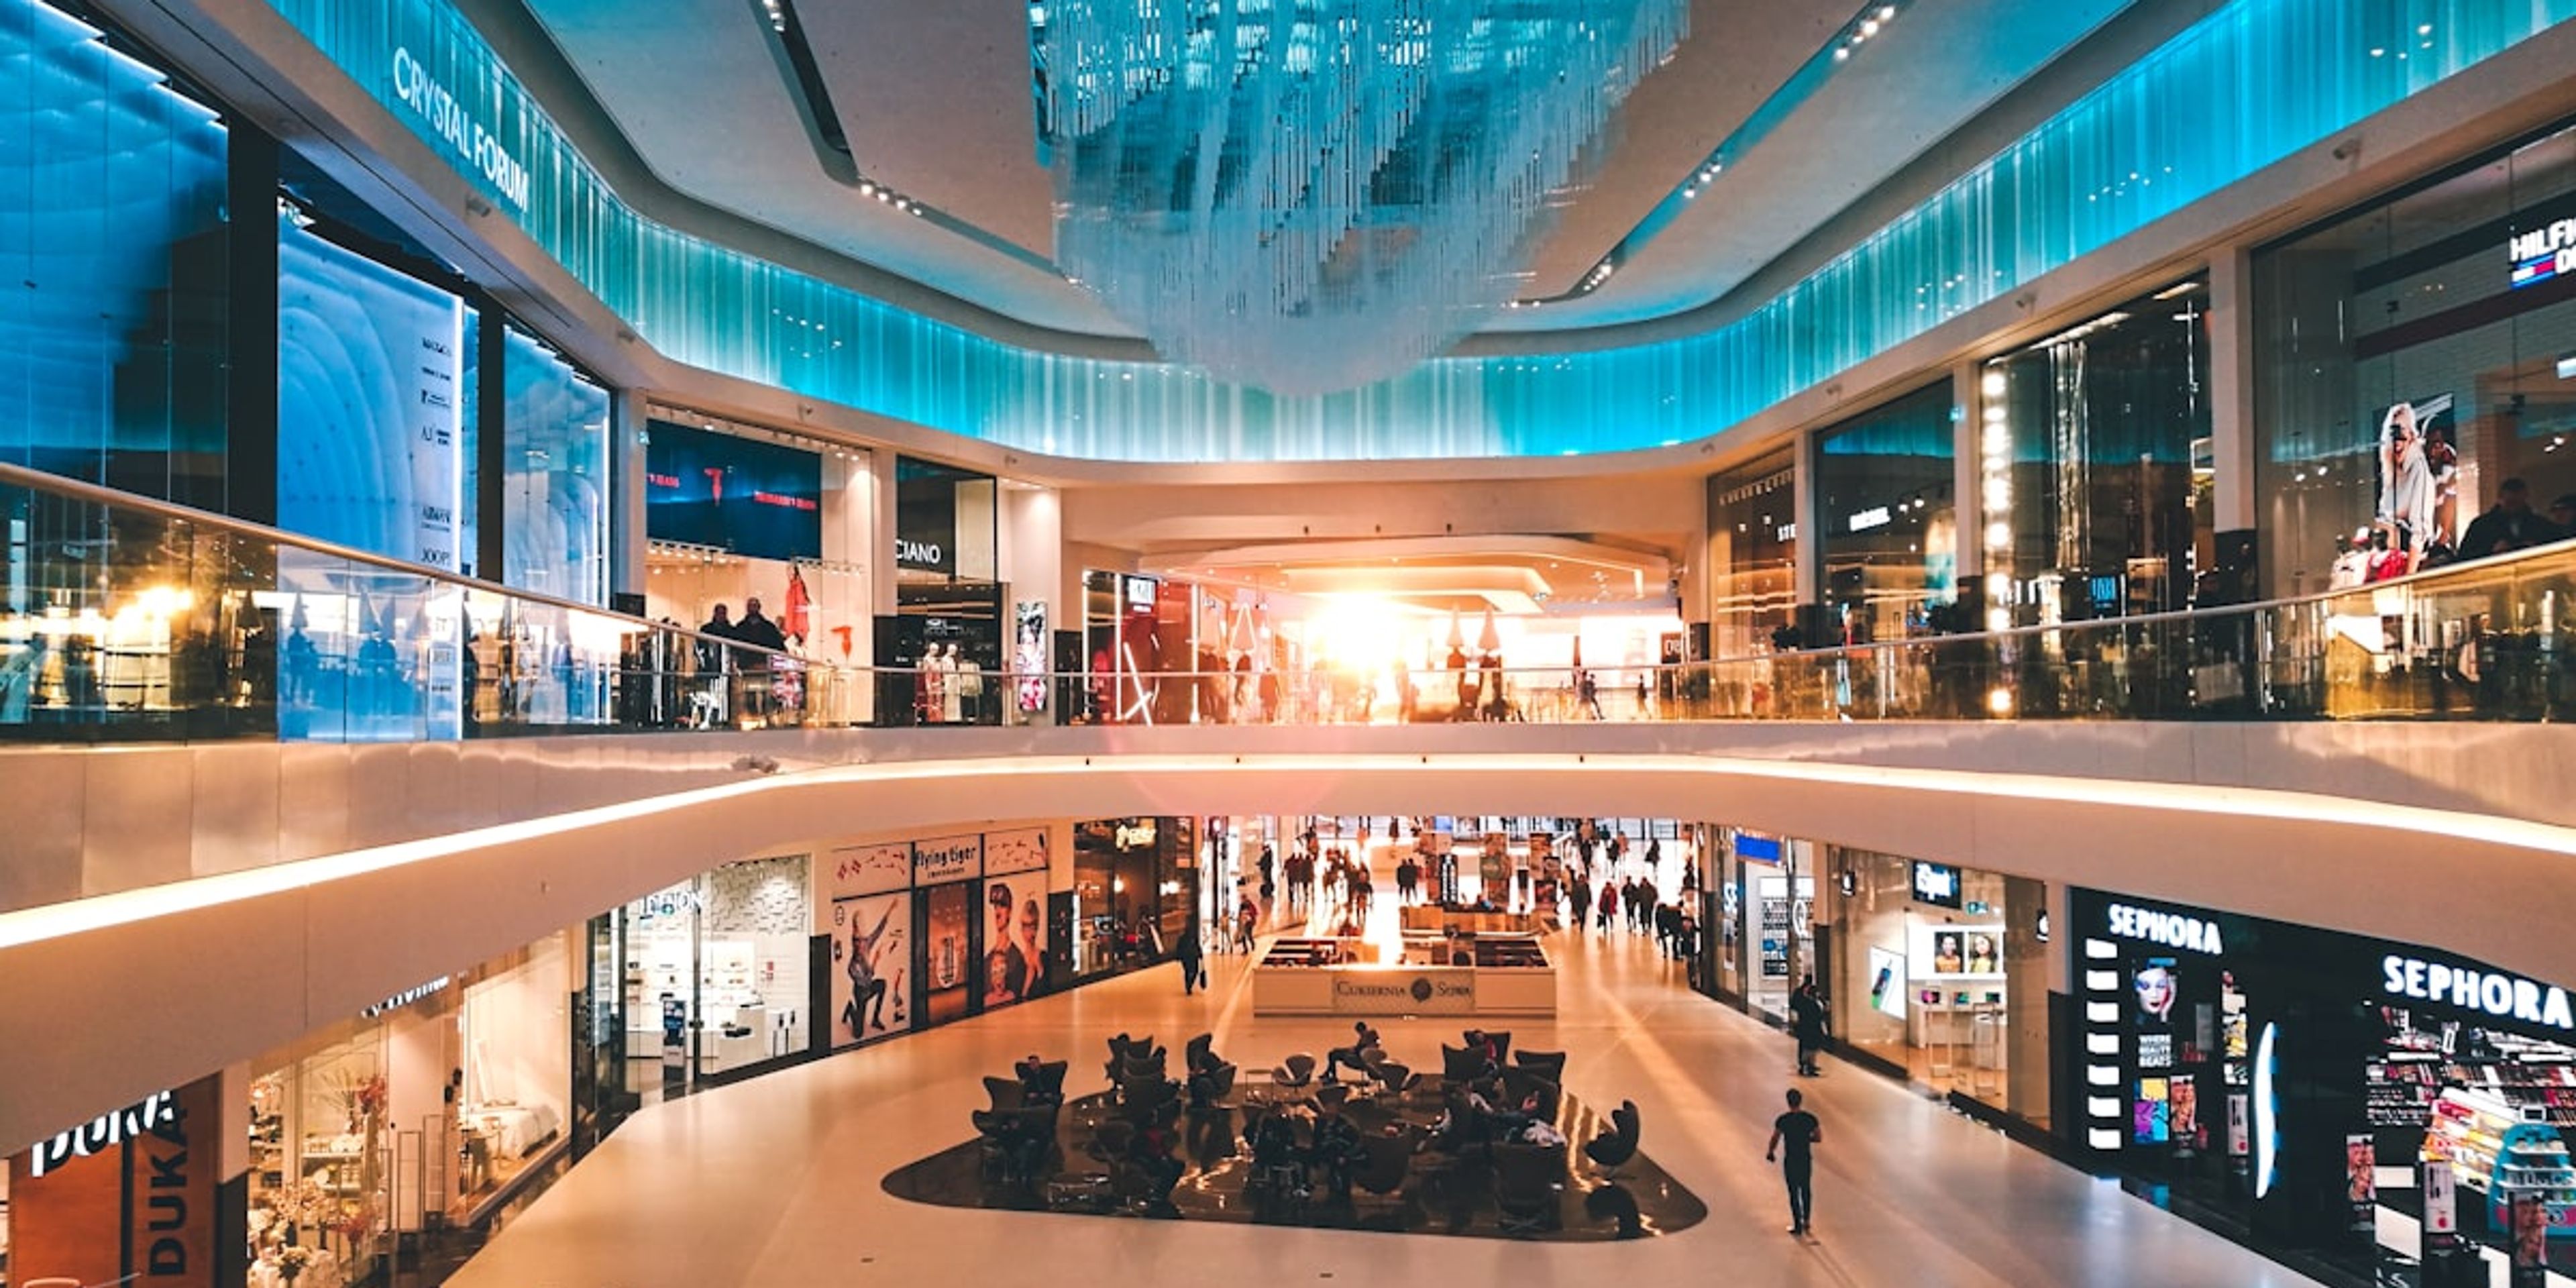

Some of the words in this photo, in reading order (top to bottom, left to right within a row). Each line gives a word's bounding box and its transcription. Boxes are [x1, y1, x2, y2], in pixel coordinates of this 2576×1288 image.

[394, 47, 471, 160] CRYSTAL
[474, 123, 529, 213] FORUM
[2510, 217, 2576, 262] HILFI
[896, 539, 941, 564] CIANO
[949, 845, 975, 864] tiger
[2108, 904, 2222, 955] SEPHORA
[2383, 955, 2574, 1029] SEPHORA
[149, 1109, 187, 1276] DUKA
